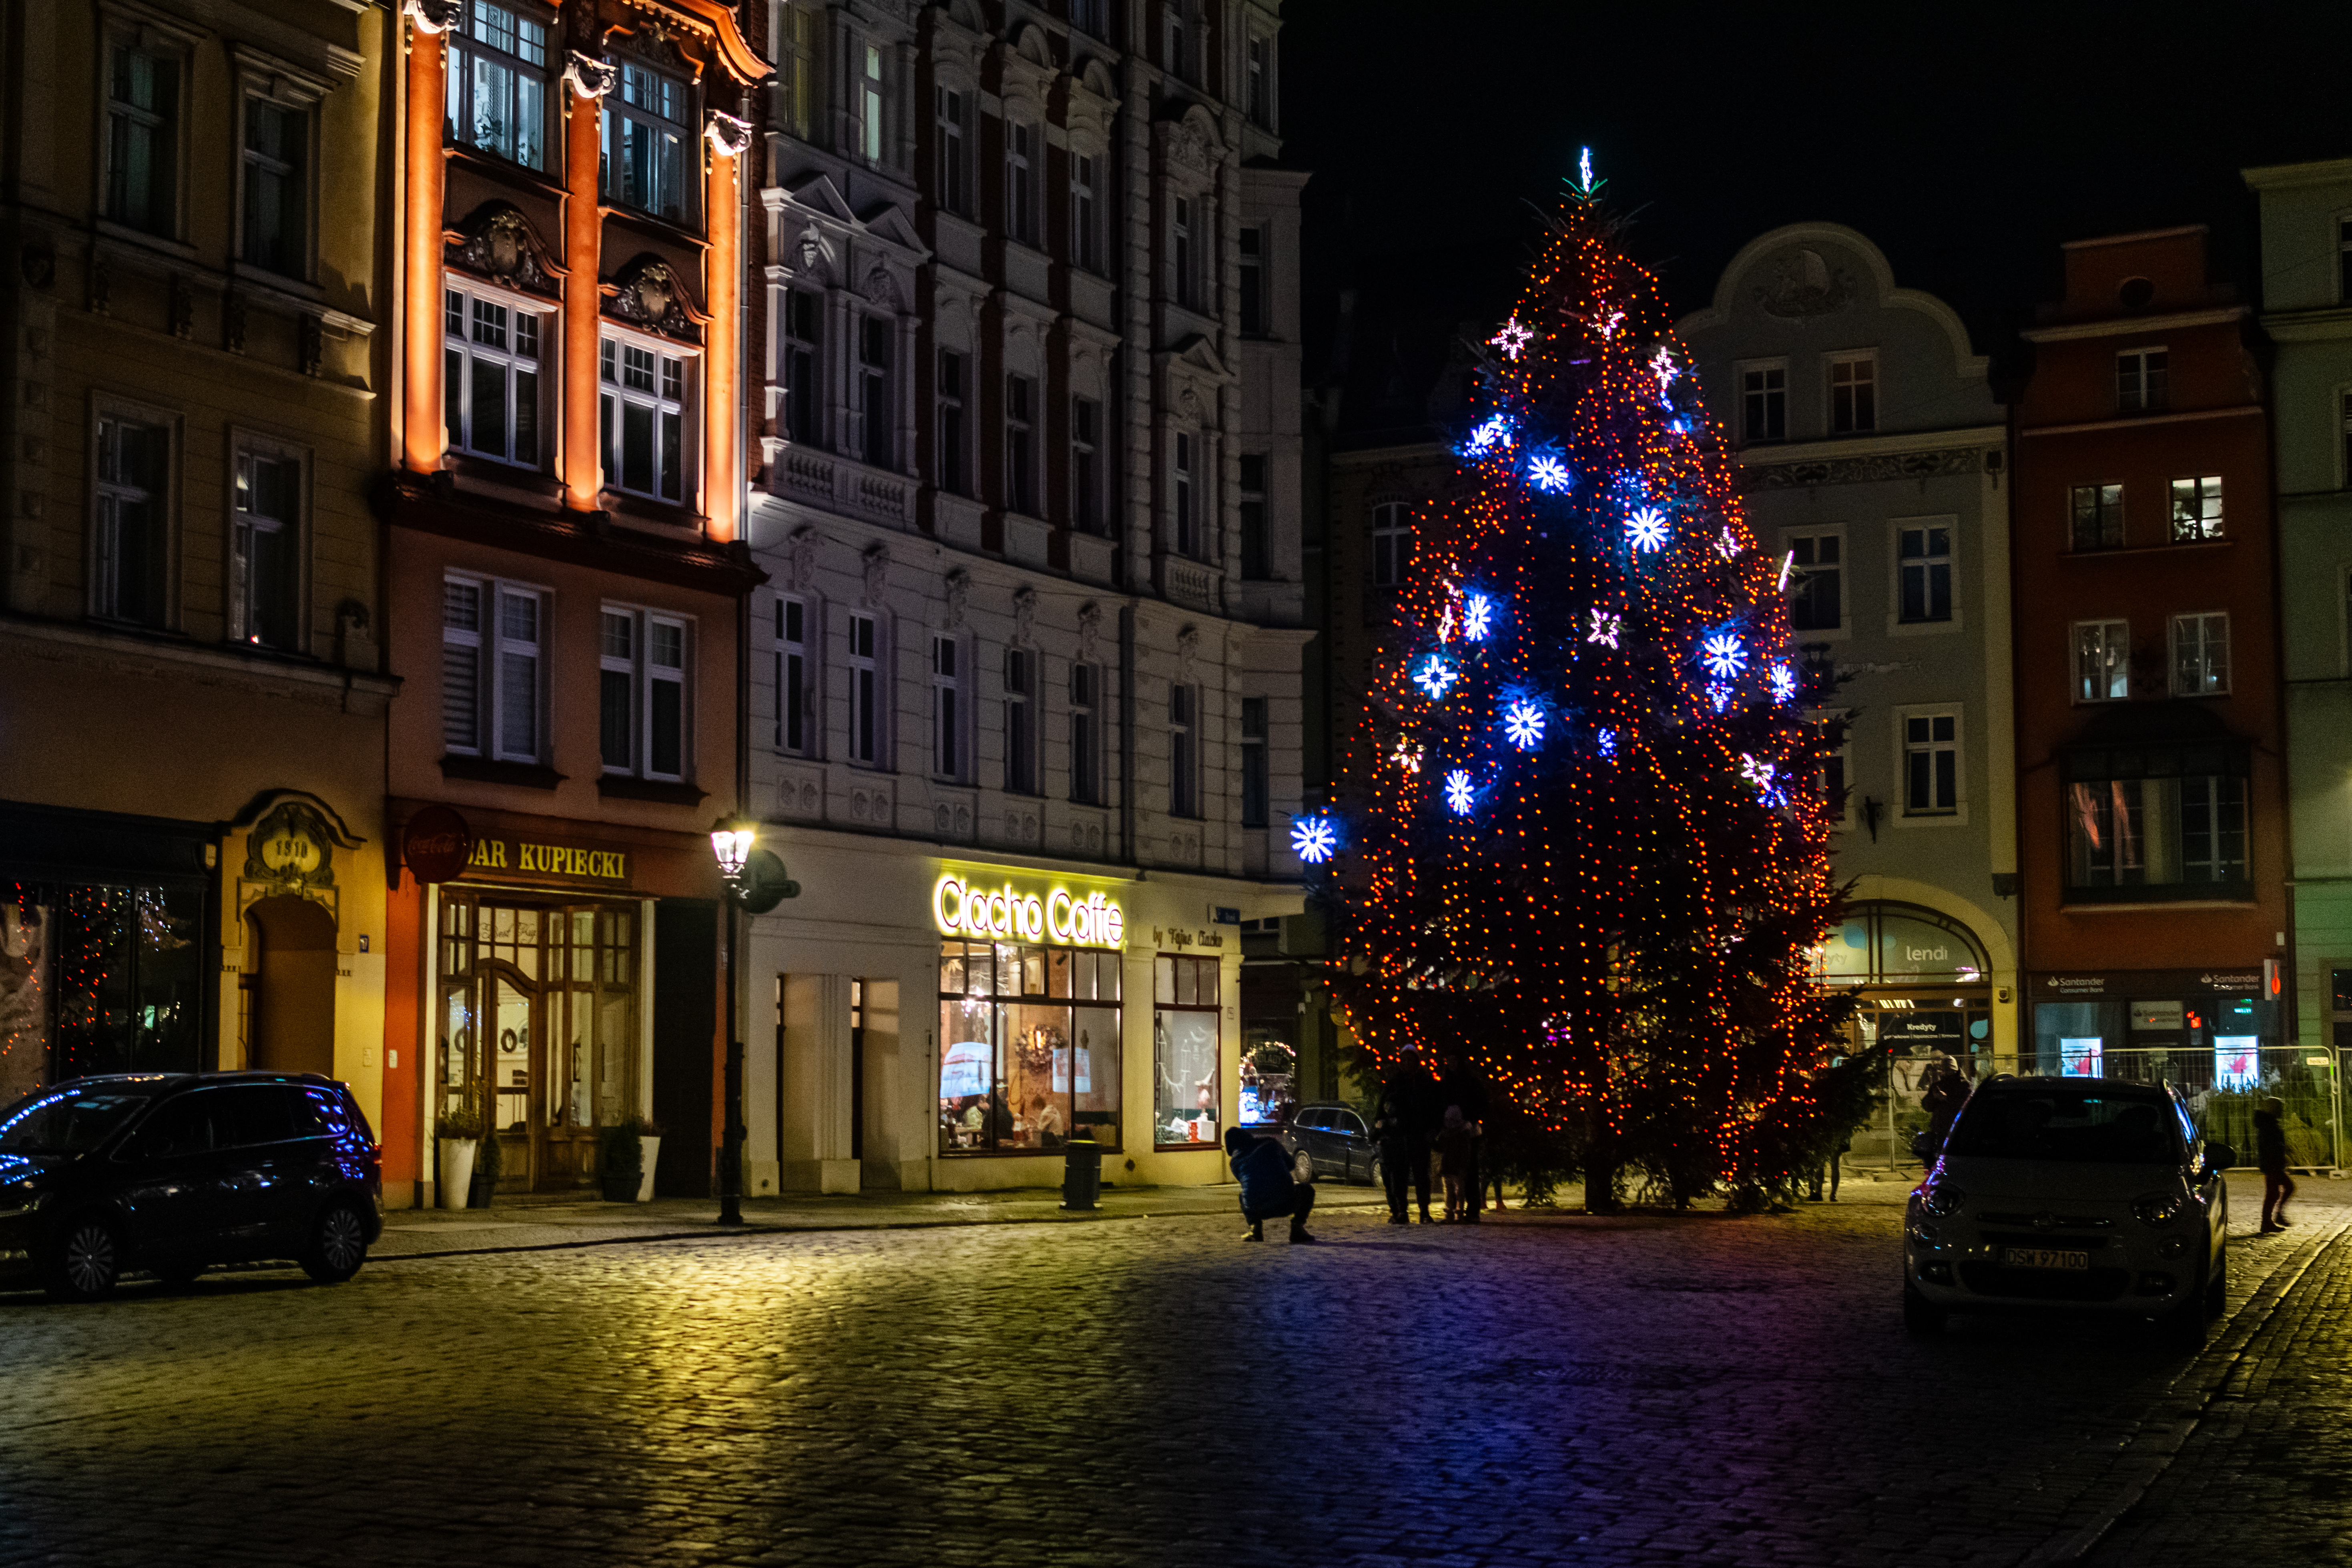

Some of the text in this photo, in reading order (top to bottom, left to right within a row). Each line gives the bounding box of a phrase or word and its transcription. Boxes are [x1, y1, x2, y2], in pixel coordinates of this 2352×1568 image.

[519, 842, 625, 879] KUPIECKI
[935, 877, 1124, 947] Ciacho Caffe
[1153, 925, 1163, 949] by
[1906, 946, 1948, 961] lendi
[2059, 978, 2105, 986] Santander
[2213, 974, 2260, 983] Santander
[1906, 1023, 1937, 1032] Kredyty
[2007, 1249, 2087, 1268] DSW 97100
